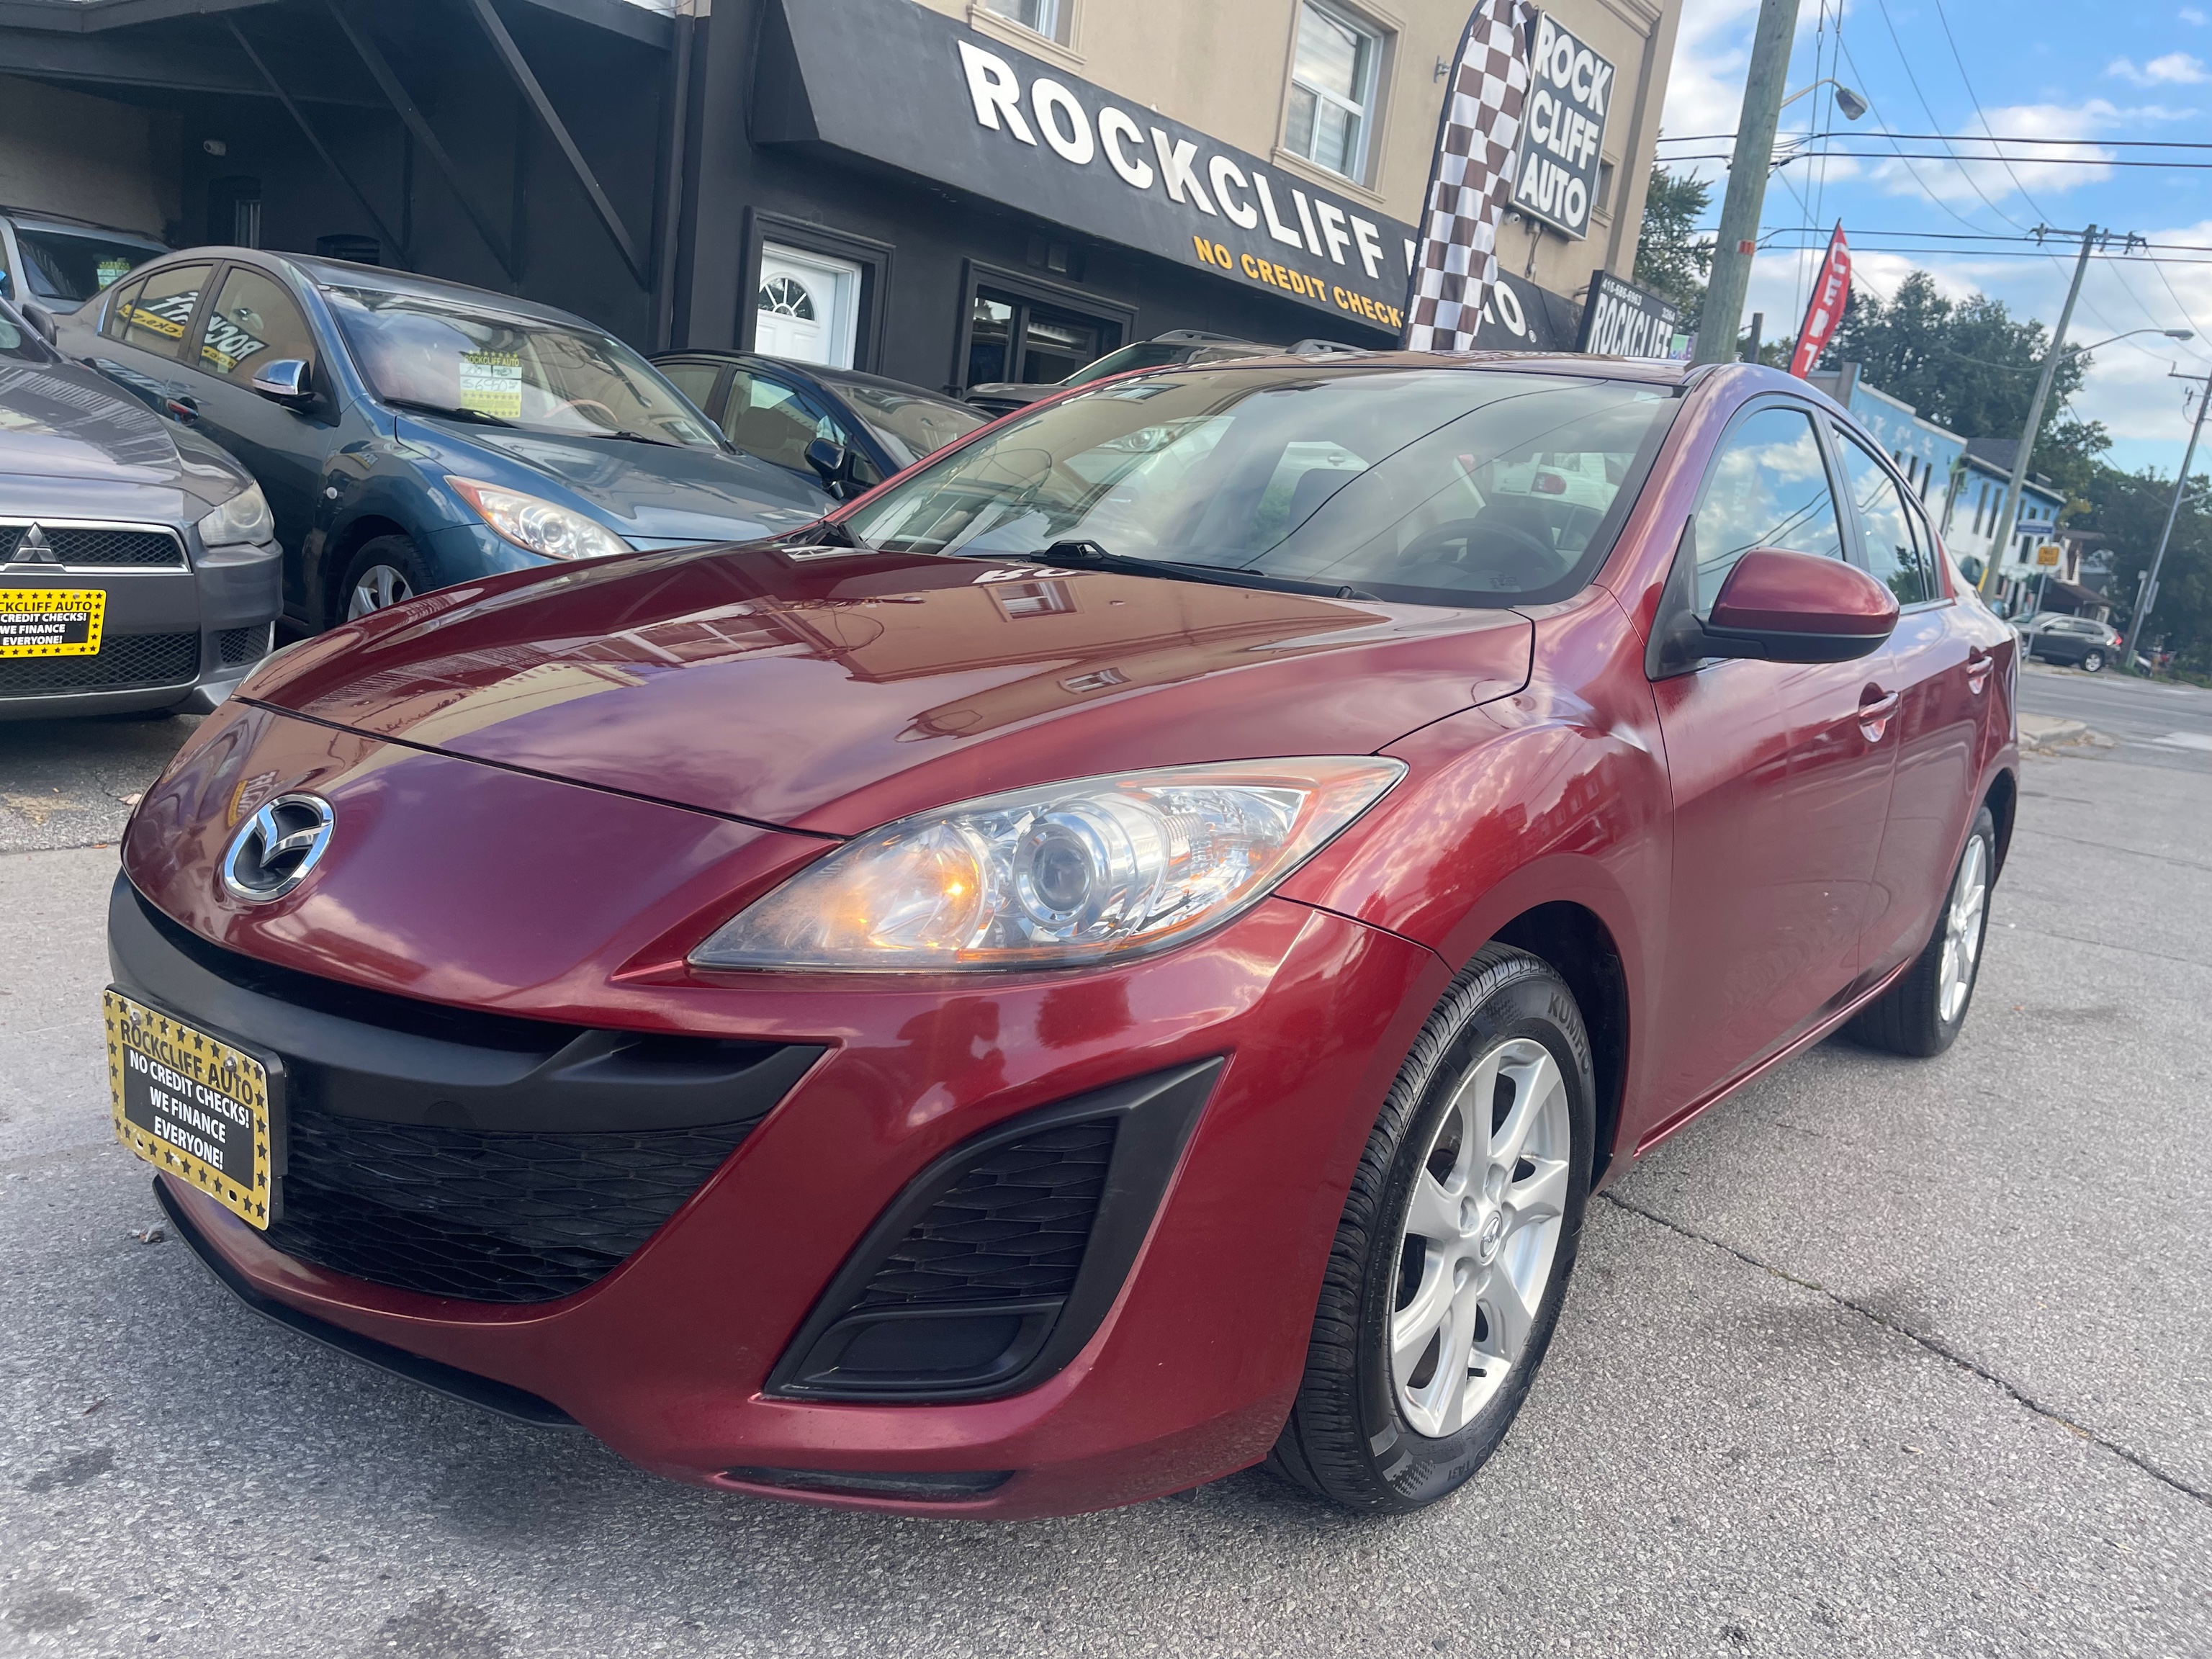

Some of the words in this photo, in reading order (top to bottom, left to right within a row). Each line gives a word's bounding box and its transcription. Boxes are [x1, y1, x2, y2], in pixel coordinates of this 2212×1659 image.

[1537, 17, 1612, 117] ROCK
[958, 40, 1385, 279] ROCKCLIFF
[1530, 89, 1600, 170] CLIFF
[1518, 152, 1587, 228] AUTO
[1193, 235, 1233, 270] NO
[1240, 253, 1326, 302] CREDIT
[1333, 286, 1404, 328] CHECK
[464, 356, 500, 365] ROCKCLIFF
[0, 625, 17, 634] WE
[19, 624, 66, 634] FINANCE
[1, 613, 40, 622] CREDIT
[42, 613, 86, 621] CHECKS!
[3, 636, 63, 645] EVERYONE!
[55, 602, 92, 611] AUTO
[120, 1019, 202, 1079] ROCKCLIFF
[208, 1064, 253, 1105] AUTO
[1548, 992, 1590, 1075] KUMHO
[130, 1049, 148, 1074] NO
[150, 1062, 192, 1098] CREDIT
[196, 1085, 250, 1128] CHECKS!
[150, 1087, 169, 1112] WE
[171, 1099, 226, 1143] FINANCE
[154, 1115, 224, 1170] EVERYONE!
